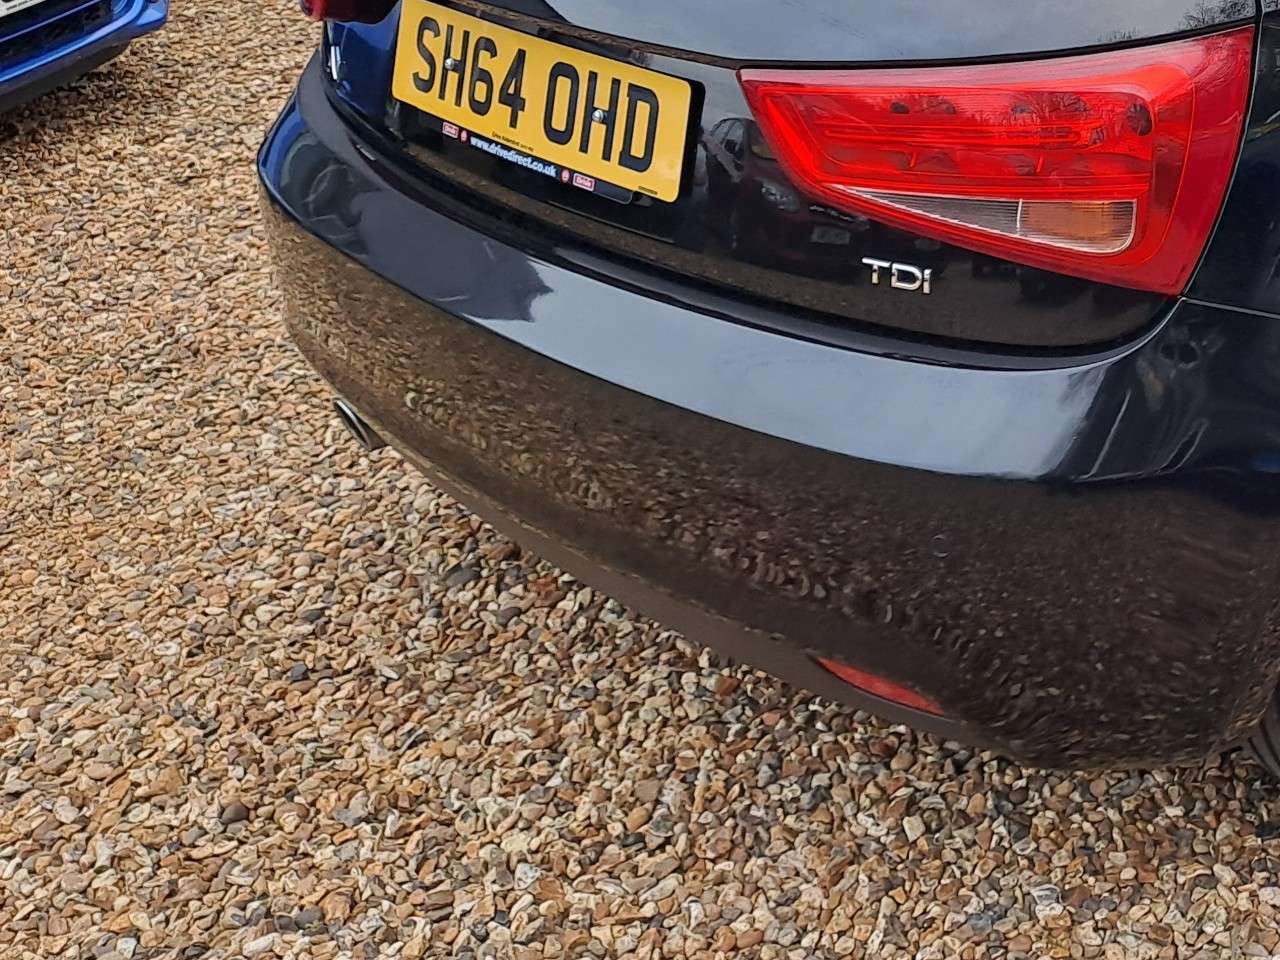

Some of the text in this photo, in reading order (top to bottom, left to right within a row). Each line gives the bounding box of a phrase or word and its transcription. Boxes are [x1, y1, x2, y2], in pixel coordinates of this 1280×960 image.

[412, 16, 660, 173] SH64 OHD
[862, 257, 932, 294] TDI
